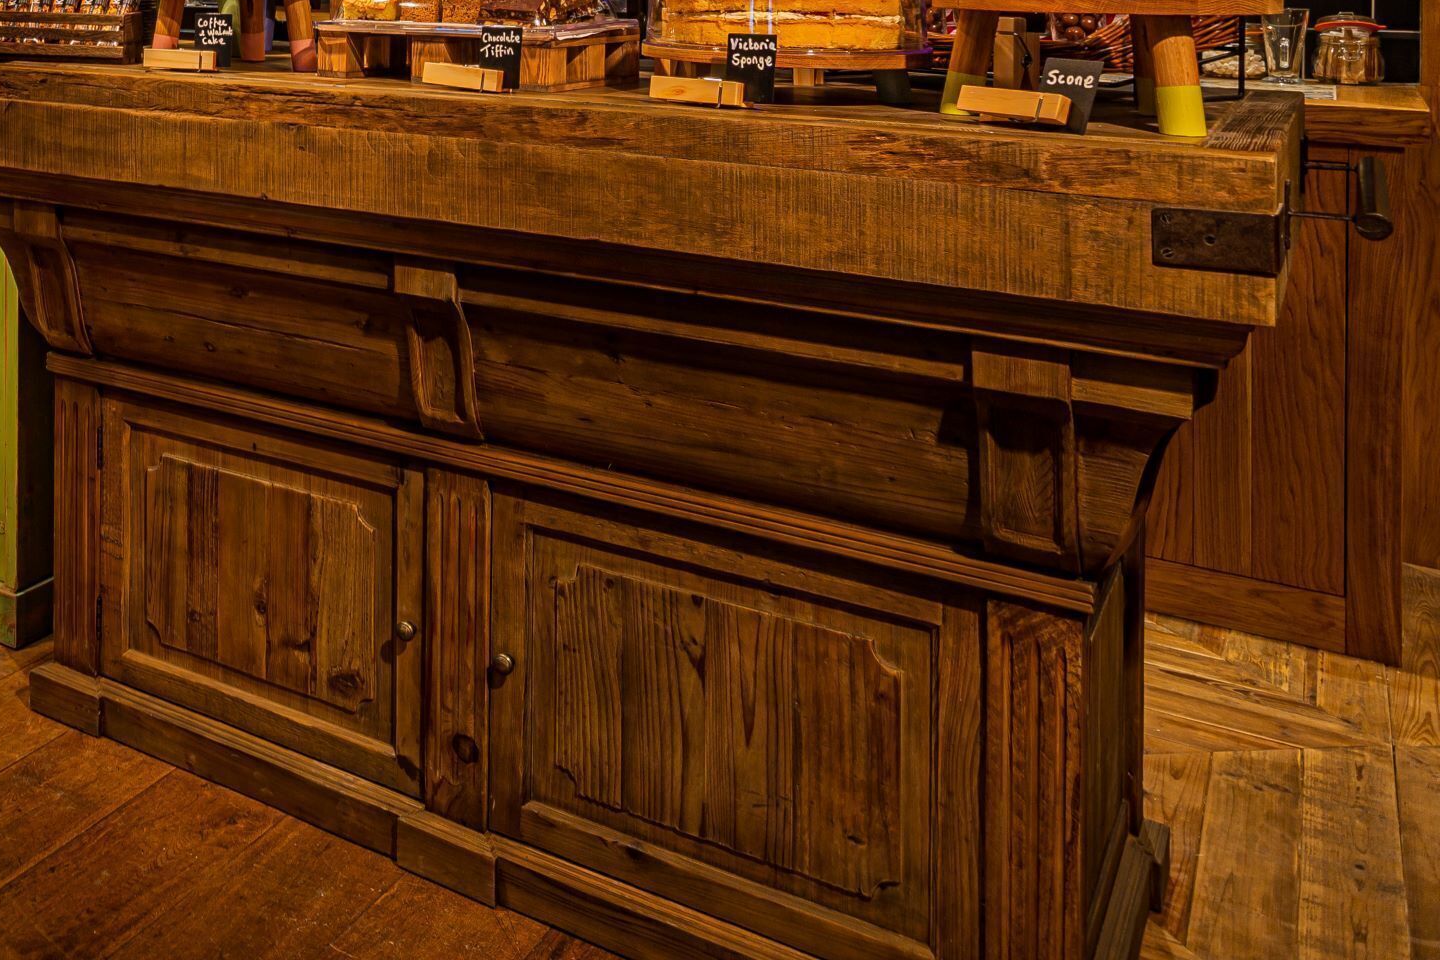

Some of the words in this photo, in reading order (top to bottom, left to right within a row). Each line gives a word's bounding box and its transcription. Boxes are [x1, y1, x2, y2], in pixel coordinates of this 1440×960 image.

[197, 17, 227, 29] Coffee
[201, 34, 226, 45] Cake
[482, 30, 521, 43] Chocolate
[480, 44, 514, 58] Tiffin
[730, 38, 777, 51] Victoria
[731, 53, 773, 71] Sponge
[1046, 69, 1094, 88] Scone
